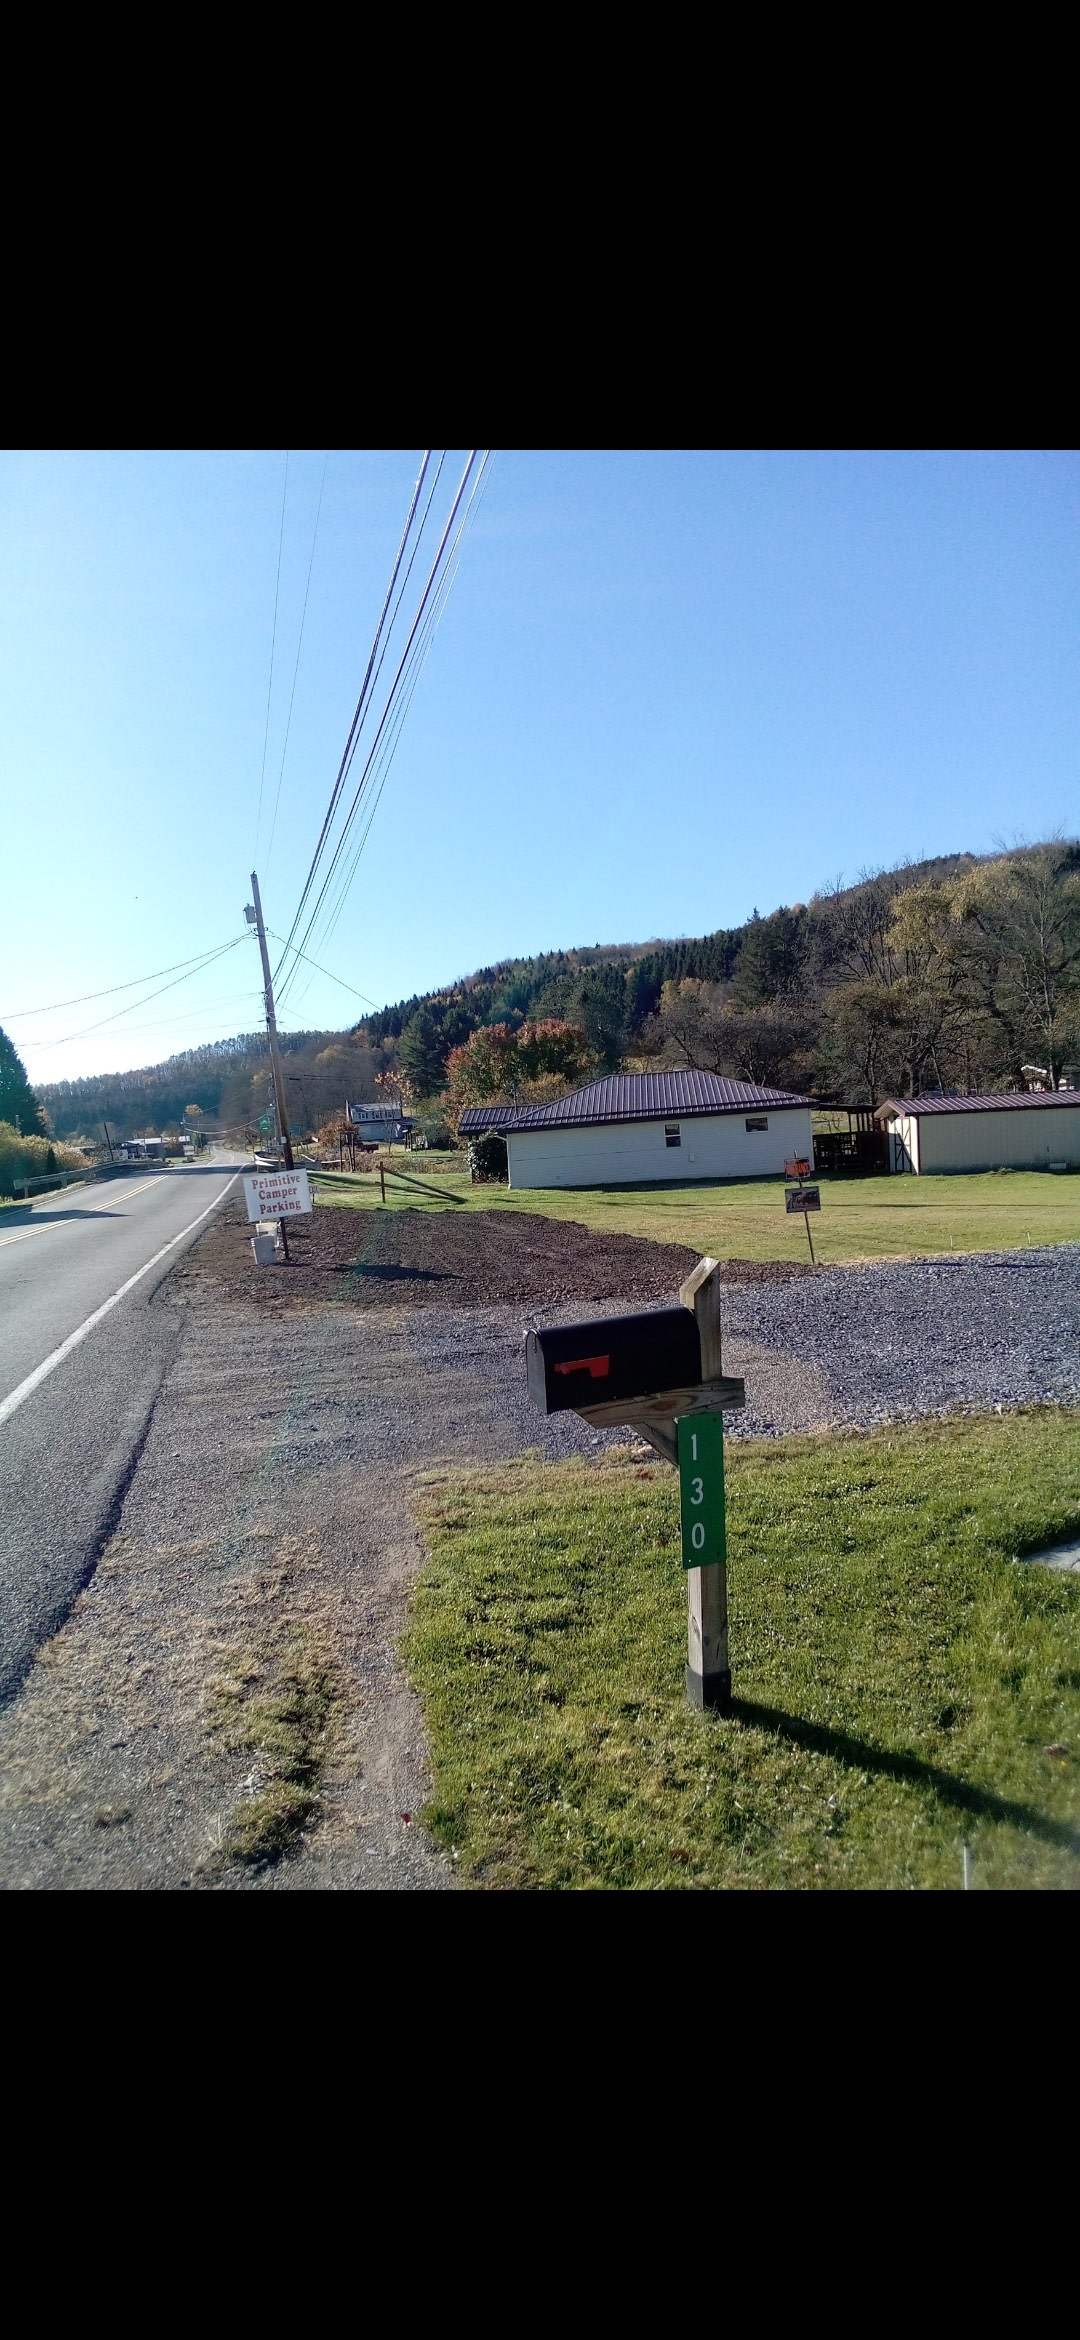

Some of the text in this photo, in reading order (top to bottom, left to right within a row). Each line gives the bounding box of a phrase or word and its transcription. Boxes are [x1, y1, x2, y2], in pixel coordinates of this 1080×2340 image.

[252, 1174, 301, 1190] Primitive
[258, 1187, 298, 1200] Camper
[259, 1200, 302, 1215] Parking
[690, 1433, 705, 1549] 130
